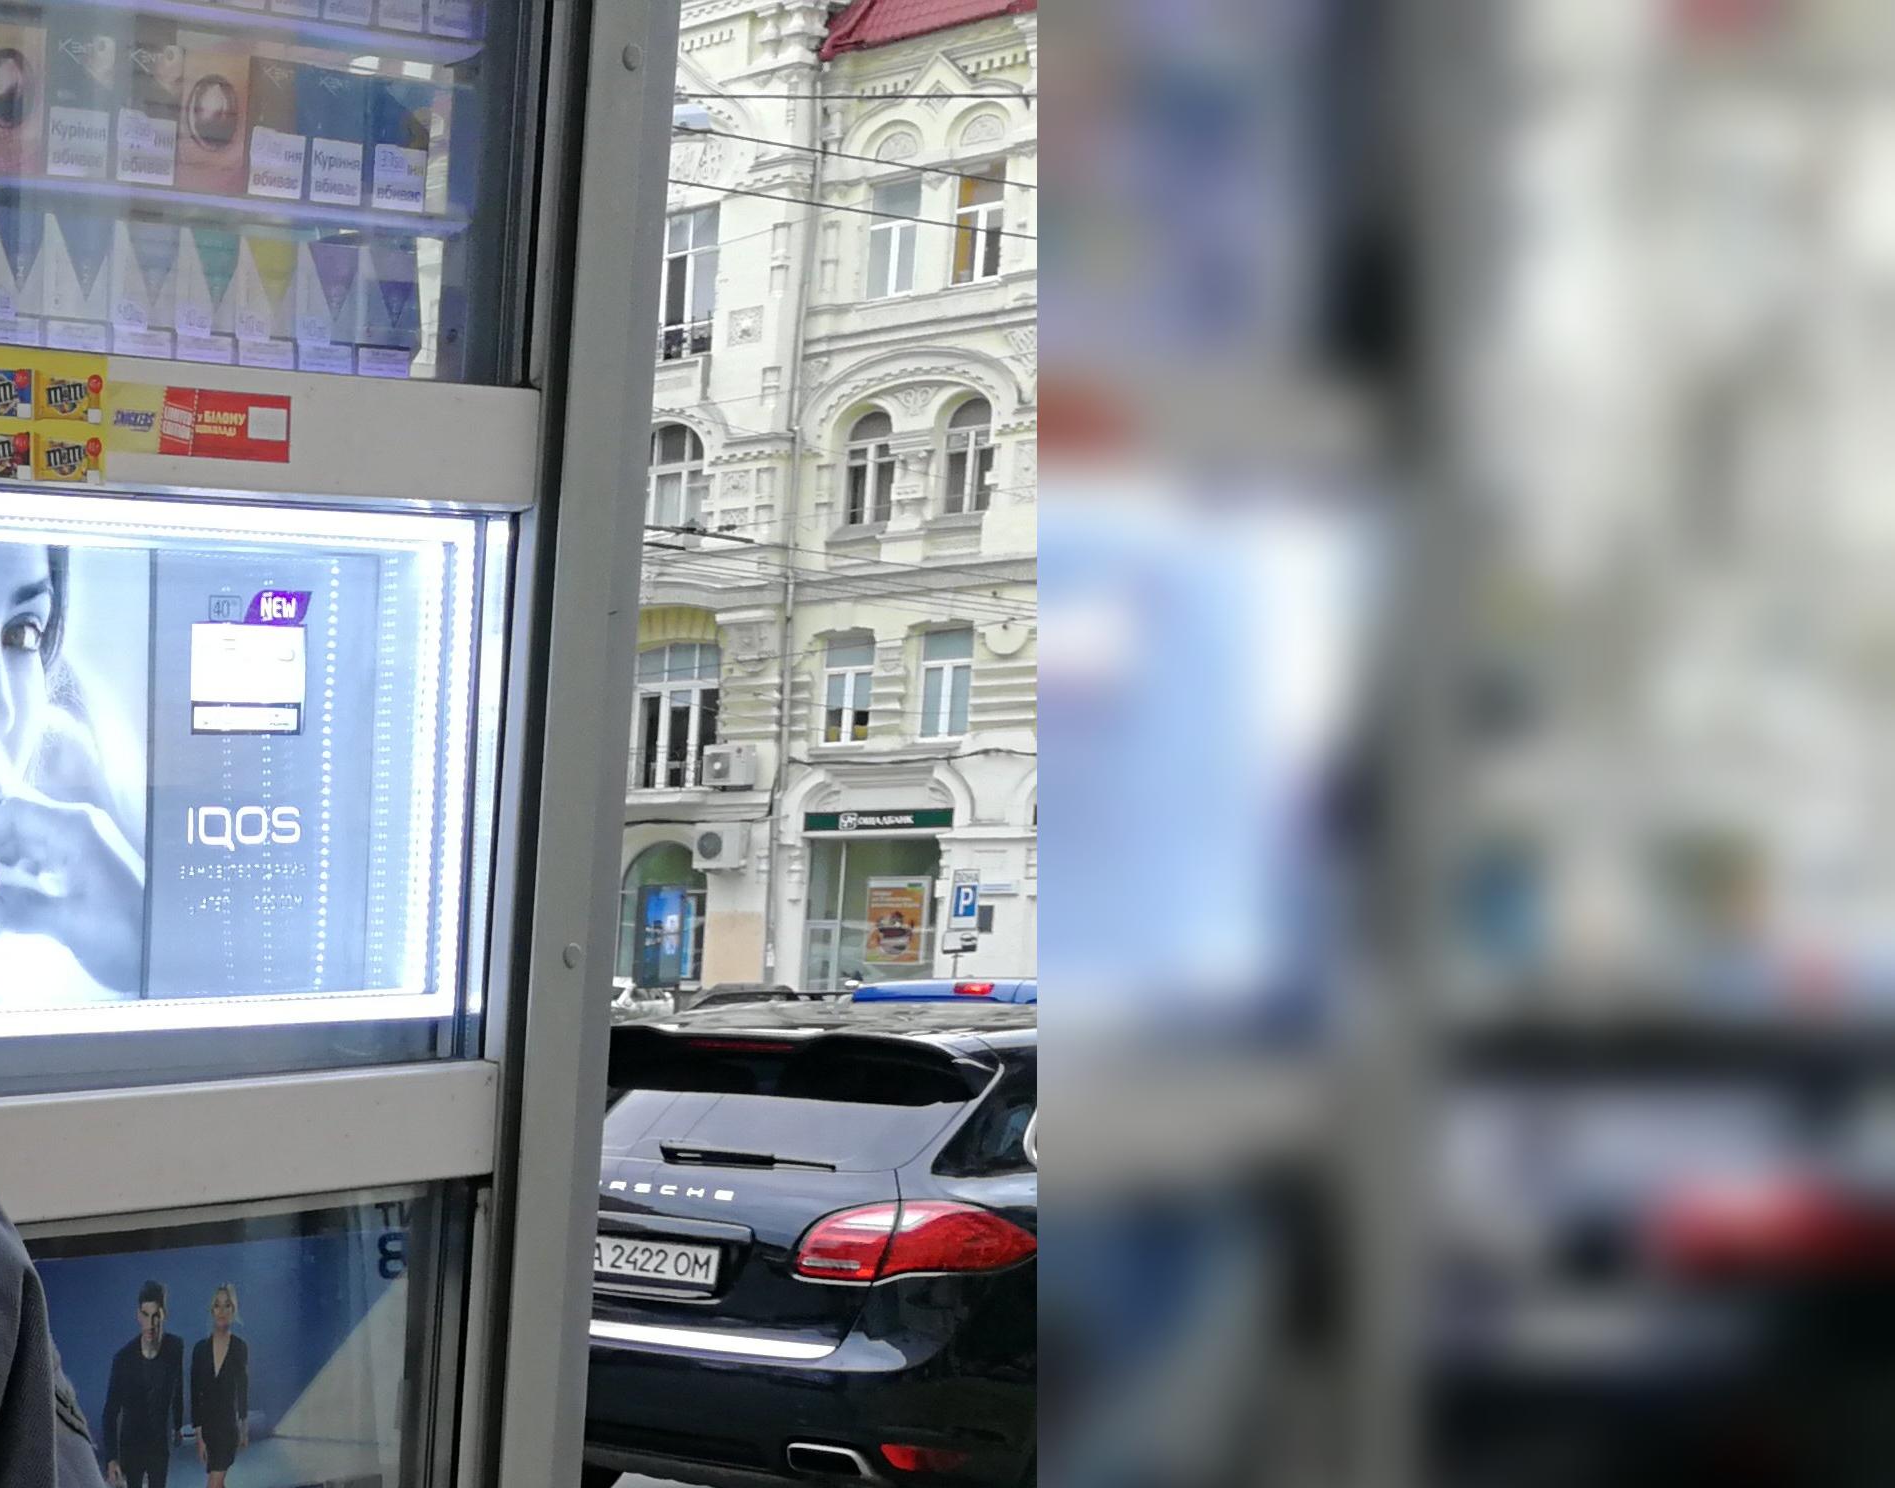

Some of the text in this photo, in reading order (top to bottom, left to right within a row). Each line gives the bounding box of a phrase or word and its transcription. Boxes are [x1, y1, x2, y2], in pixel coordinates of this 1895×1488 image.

[260, 592, 297, 622] NEW
[187, 806, 301, 851] IQOS
[960, 888, 973, 914] P
[611, 1244, 668, 1274] 2422
